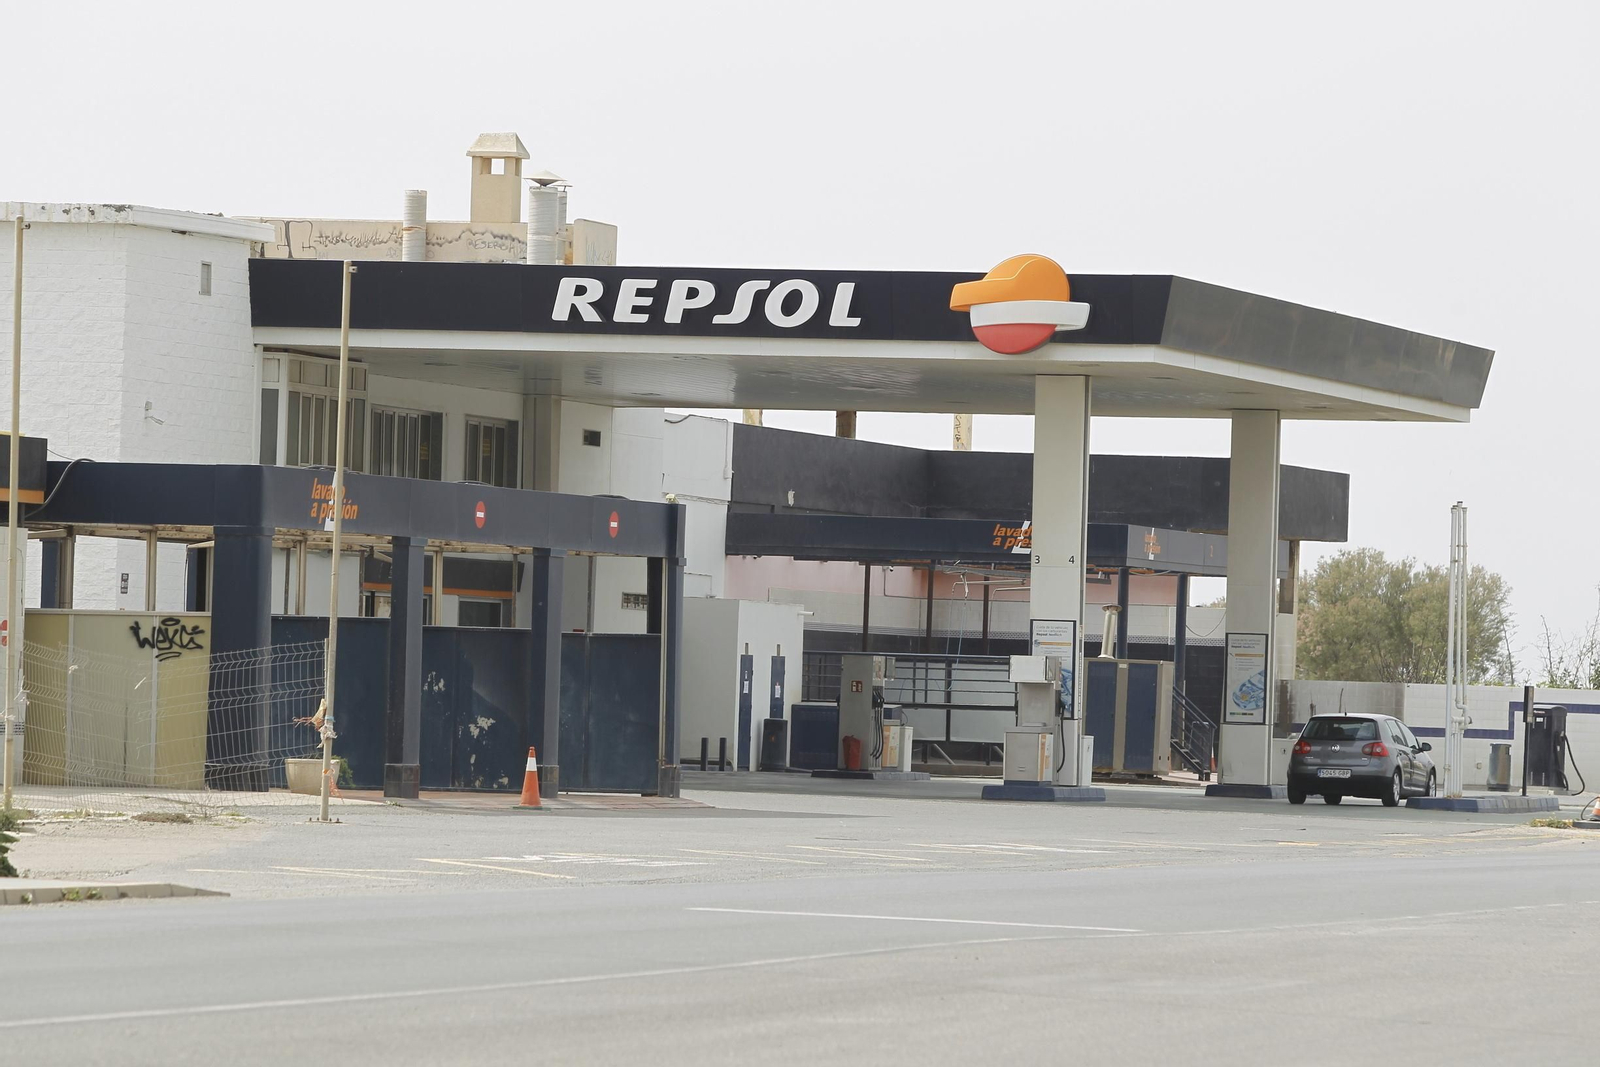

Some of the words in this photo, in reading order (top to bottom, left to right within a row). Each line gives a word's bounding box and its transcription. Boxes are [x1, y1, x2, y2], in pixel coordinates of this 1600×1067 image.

[552, 277, 861, 328] REPSOL
[310, 502, 319, 517] a
[319, 499, 358, 524] preión
[993, 523, 1032, 537] lavad
[993, 537, 1002, 546] a
[1034, 555, 1041, 565] 3
[1068, 555, 1075, 565] 4
